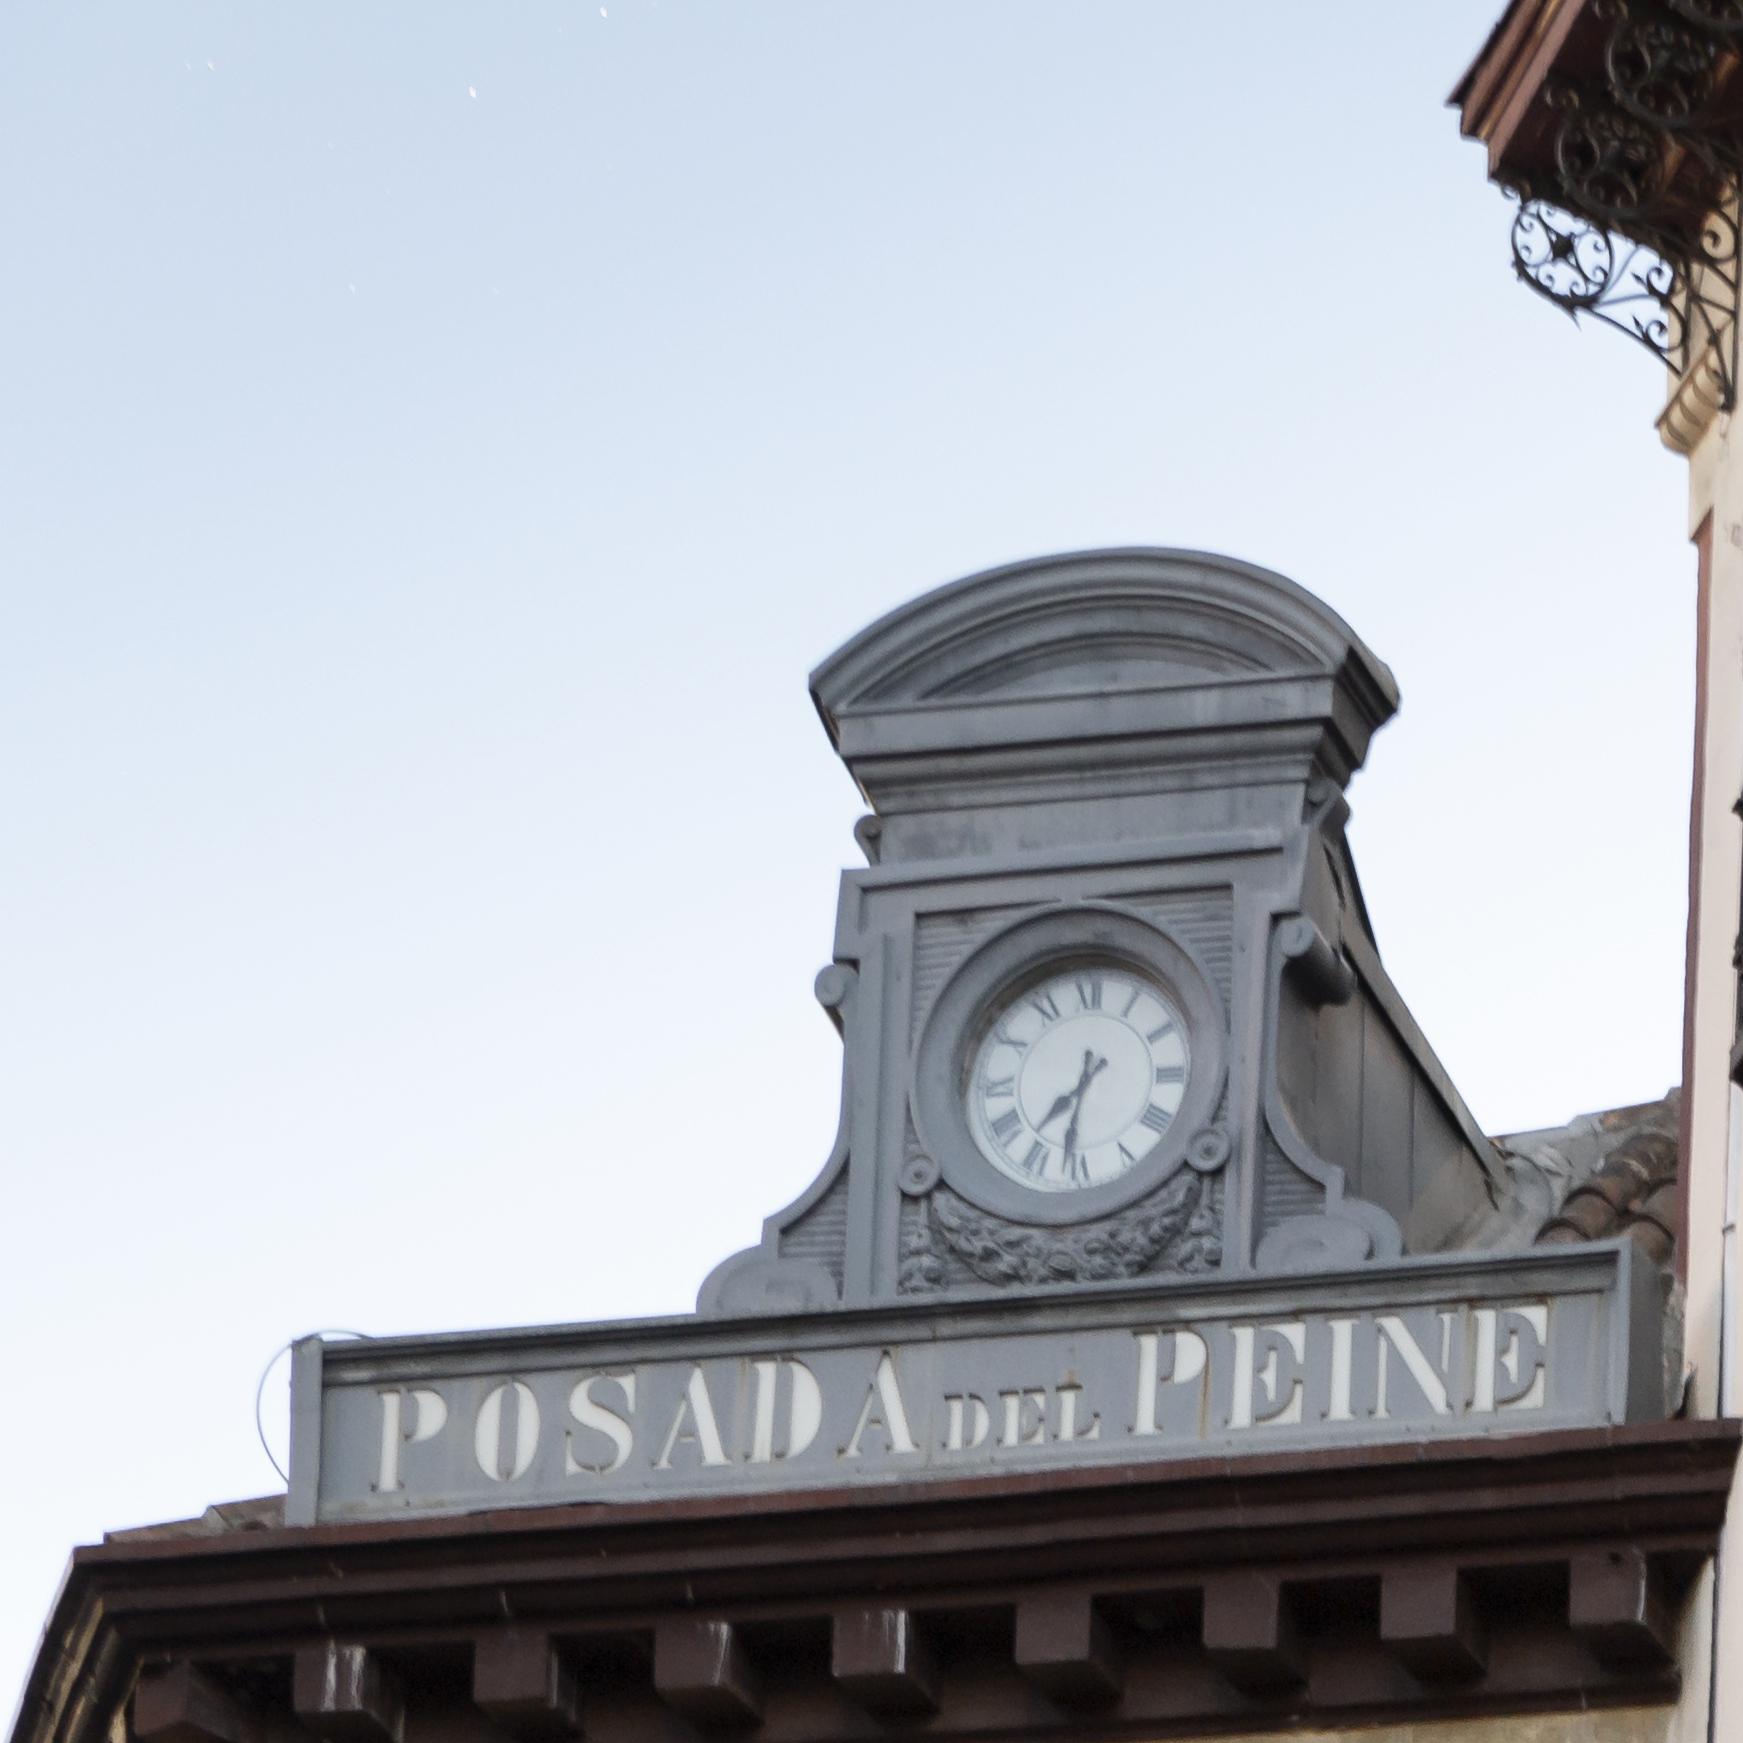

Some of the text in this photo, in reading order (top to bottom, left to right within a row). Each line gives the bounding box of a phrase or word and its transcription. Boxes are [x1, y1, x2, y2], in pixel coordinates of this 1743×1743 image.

[370, 1298, 1550, 1493] POSADA DEL PEINE
